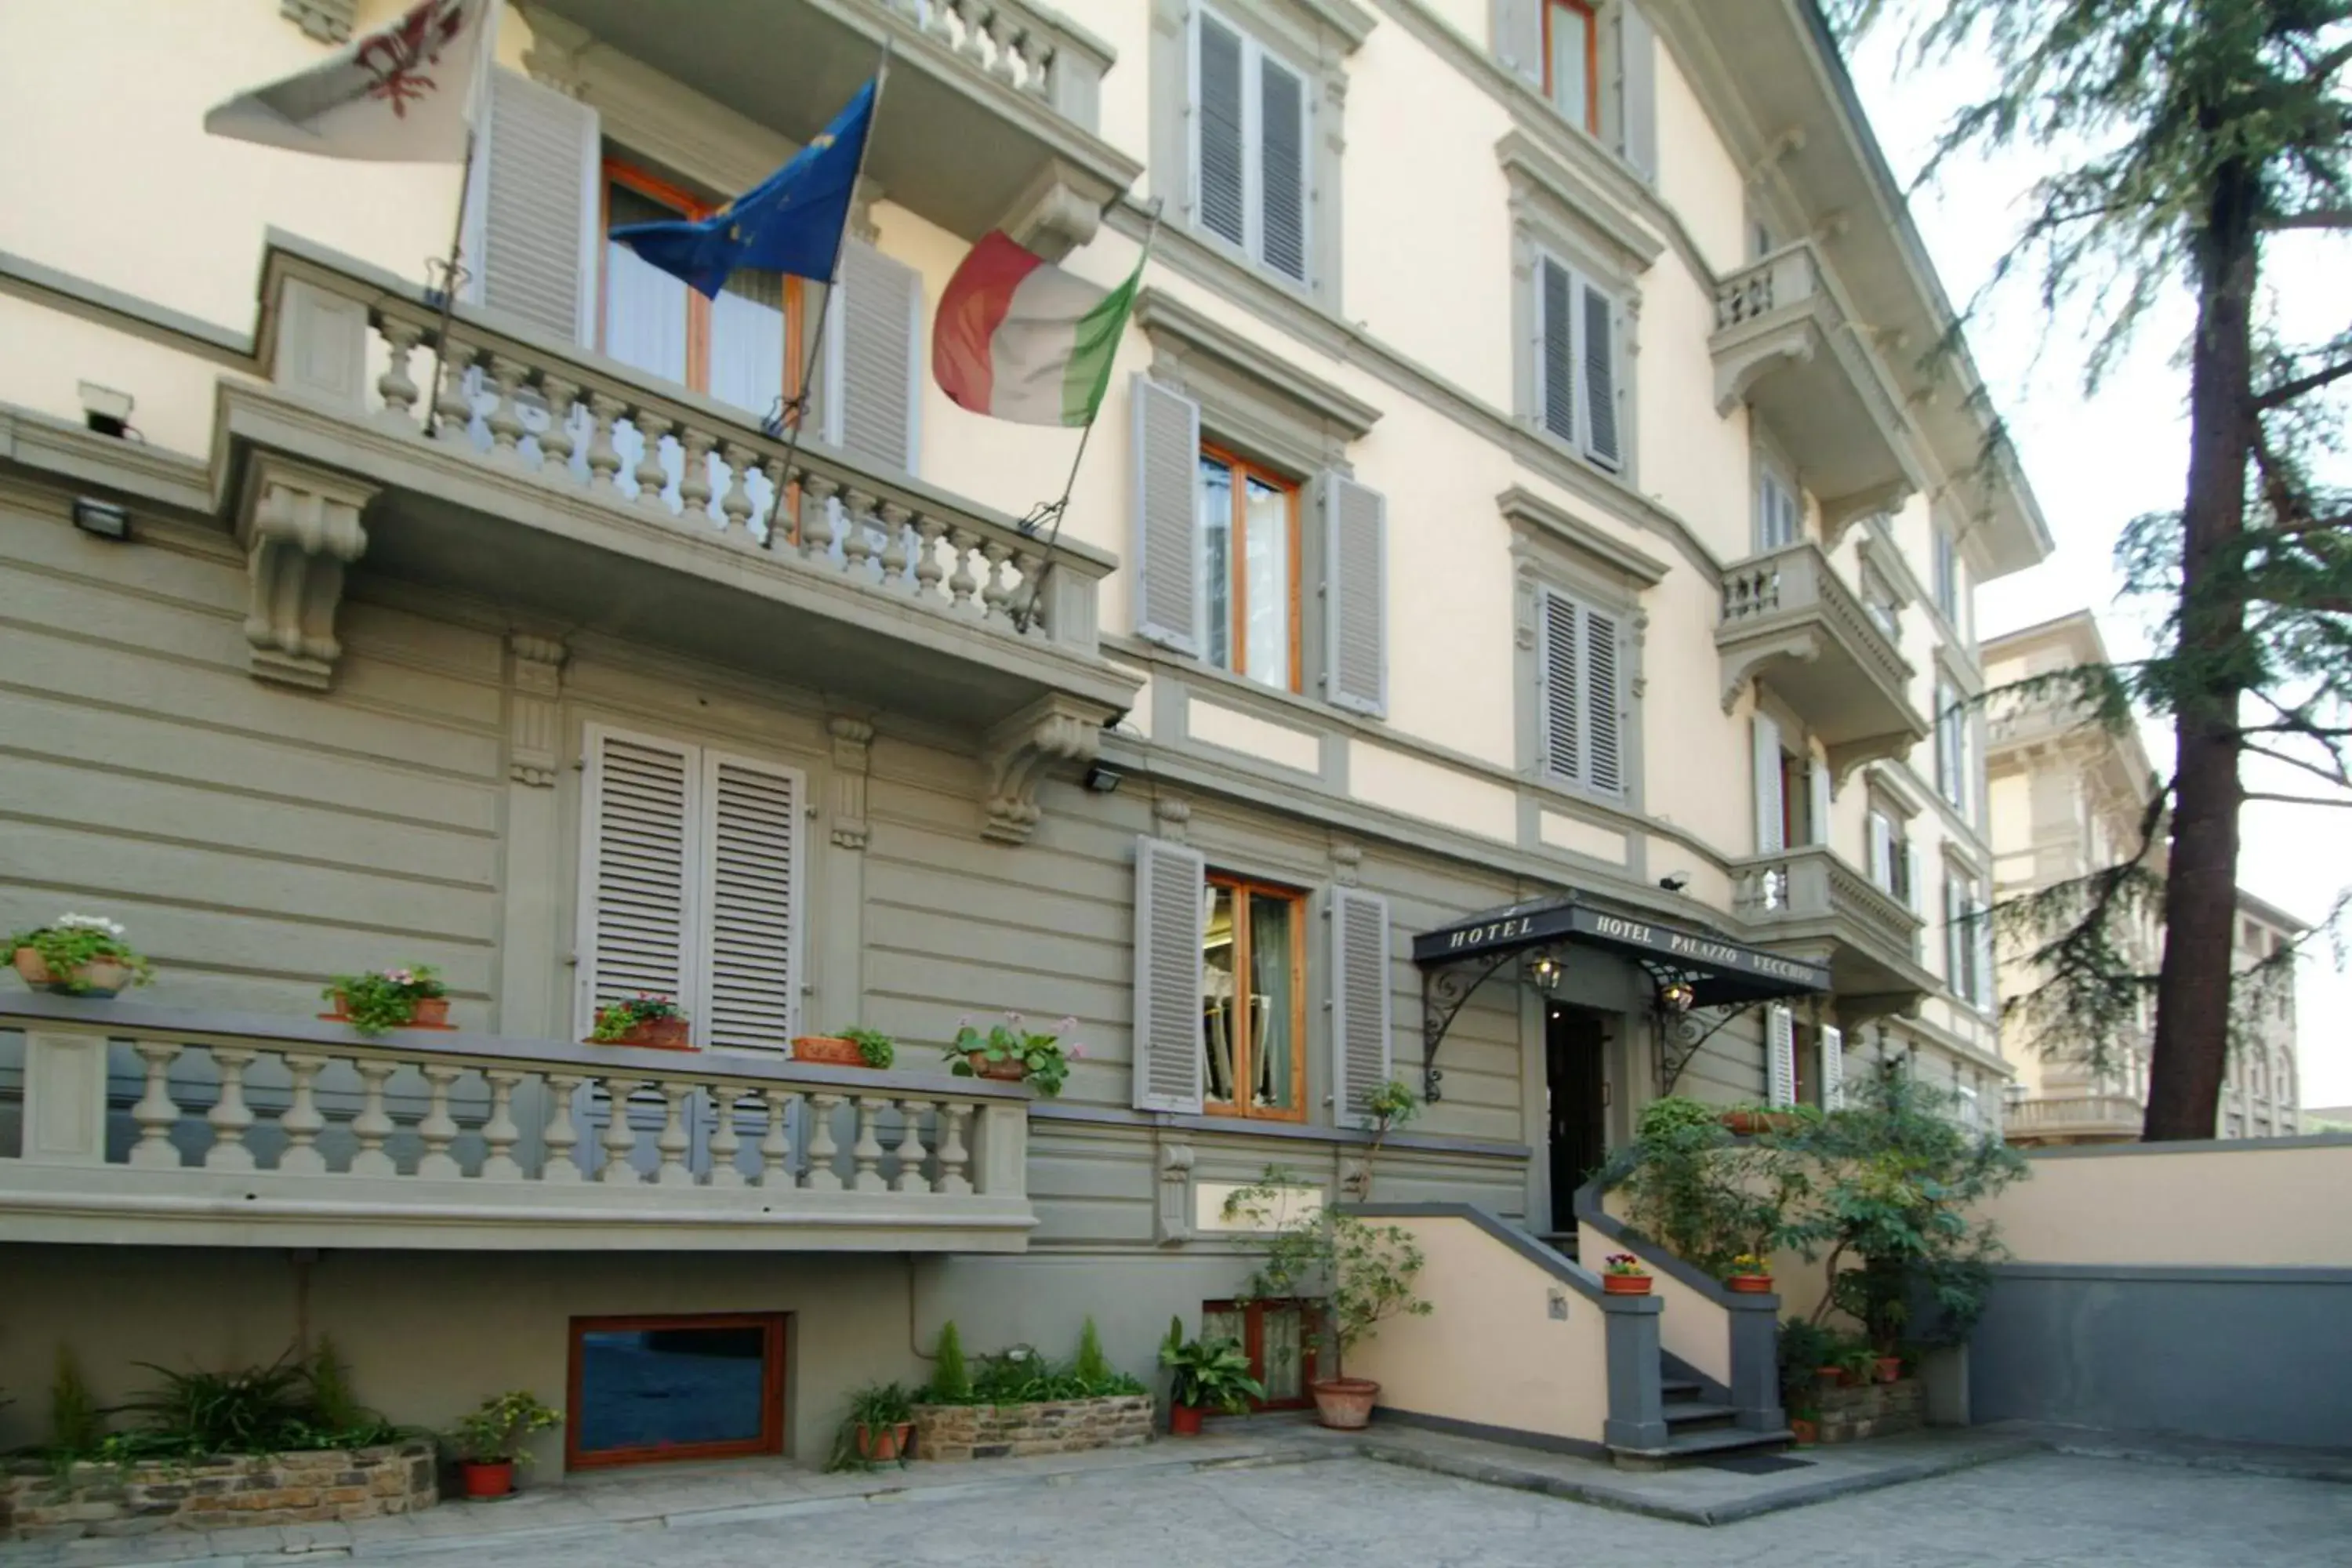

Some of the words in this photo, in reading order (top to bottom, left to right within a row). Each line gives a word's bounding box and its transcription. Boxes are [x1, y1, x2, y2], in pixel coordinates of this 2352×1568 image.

[1450, 916, 1534, 948] HOTEL
[1596, 915, 1652, 943] HOTEL
[1671, 934, 1737, 963] PALAZZO
